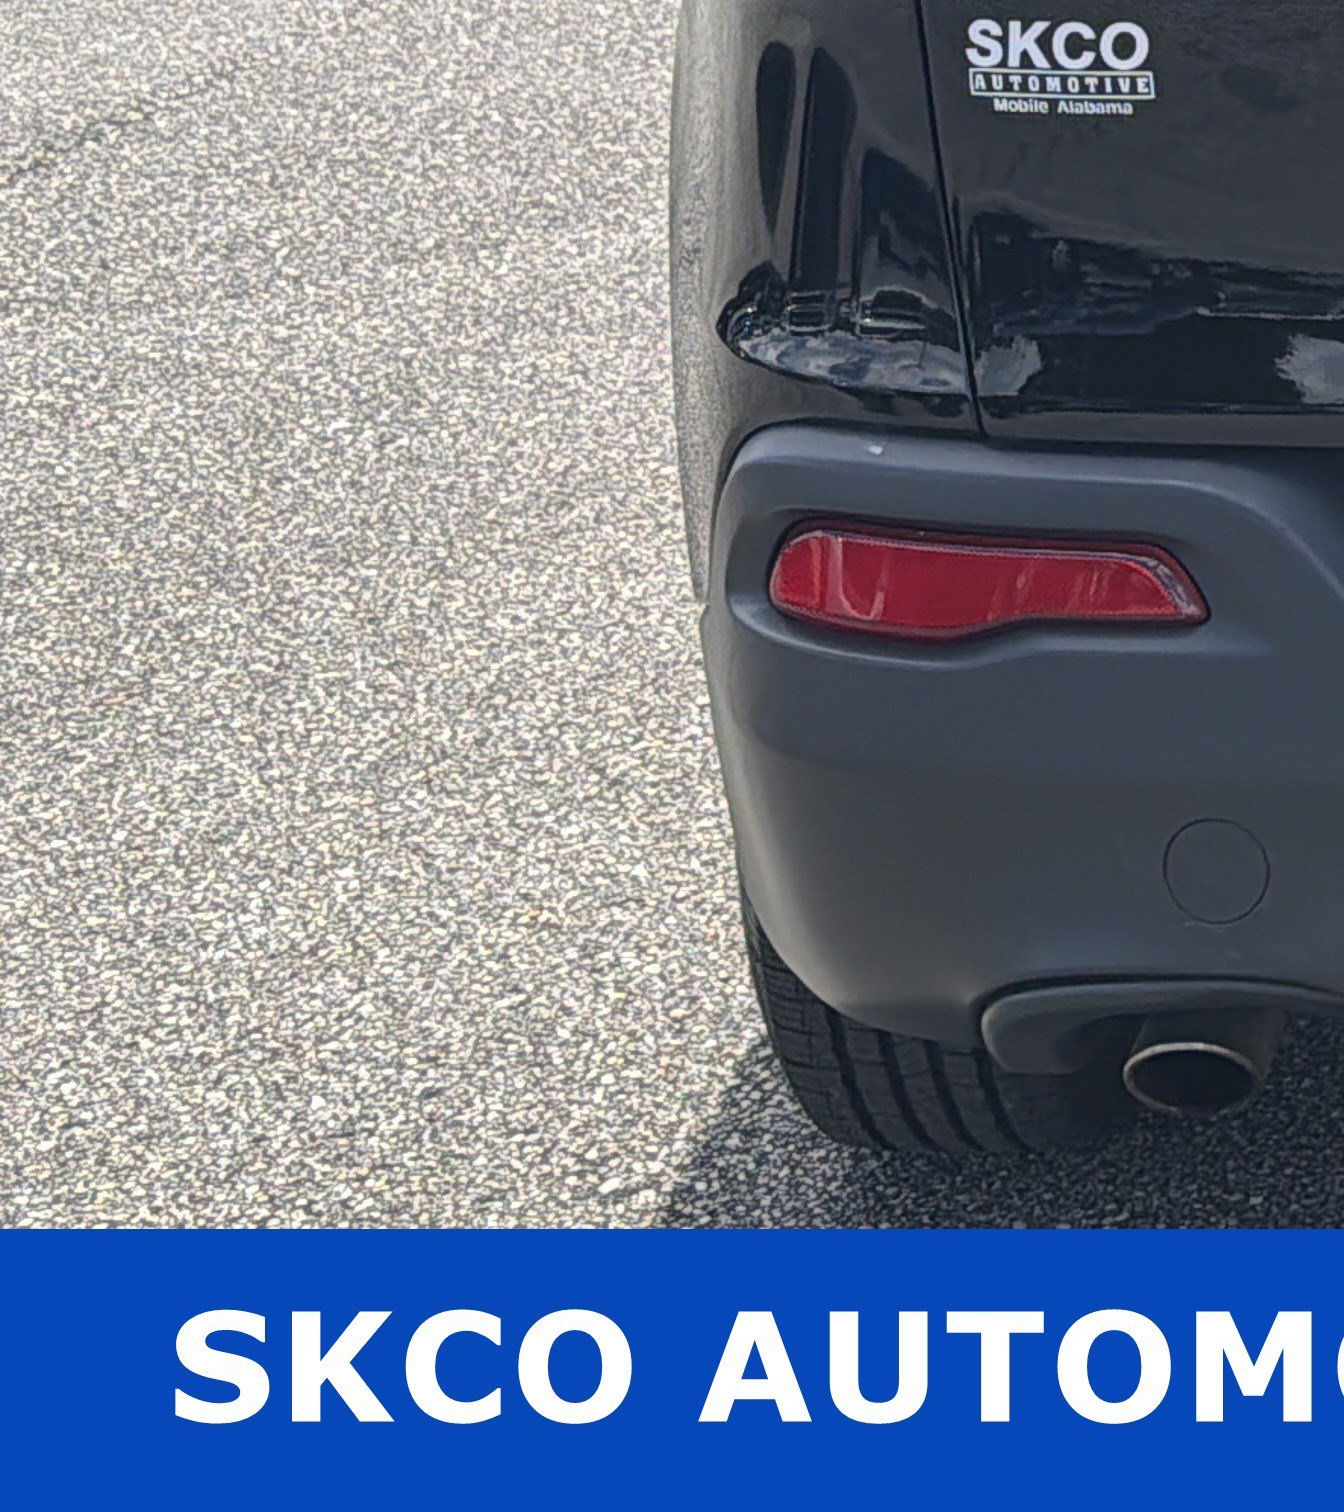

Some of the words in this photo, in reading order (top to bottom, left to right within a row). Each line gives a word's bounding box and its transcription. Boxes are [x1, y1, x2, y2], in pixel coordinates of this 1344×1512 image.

[965, 18, 1149, 70] SKCO
[975, 74, 1150, 93] AUTOMOTIVE
[993, 97, 1049, 113] Mobile
[1057, 100, 1134, 115] Alabama
